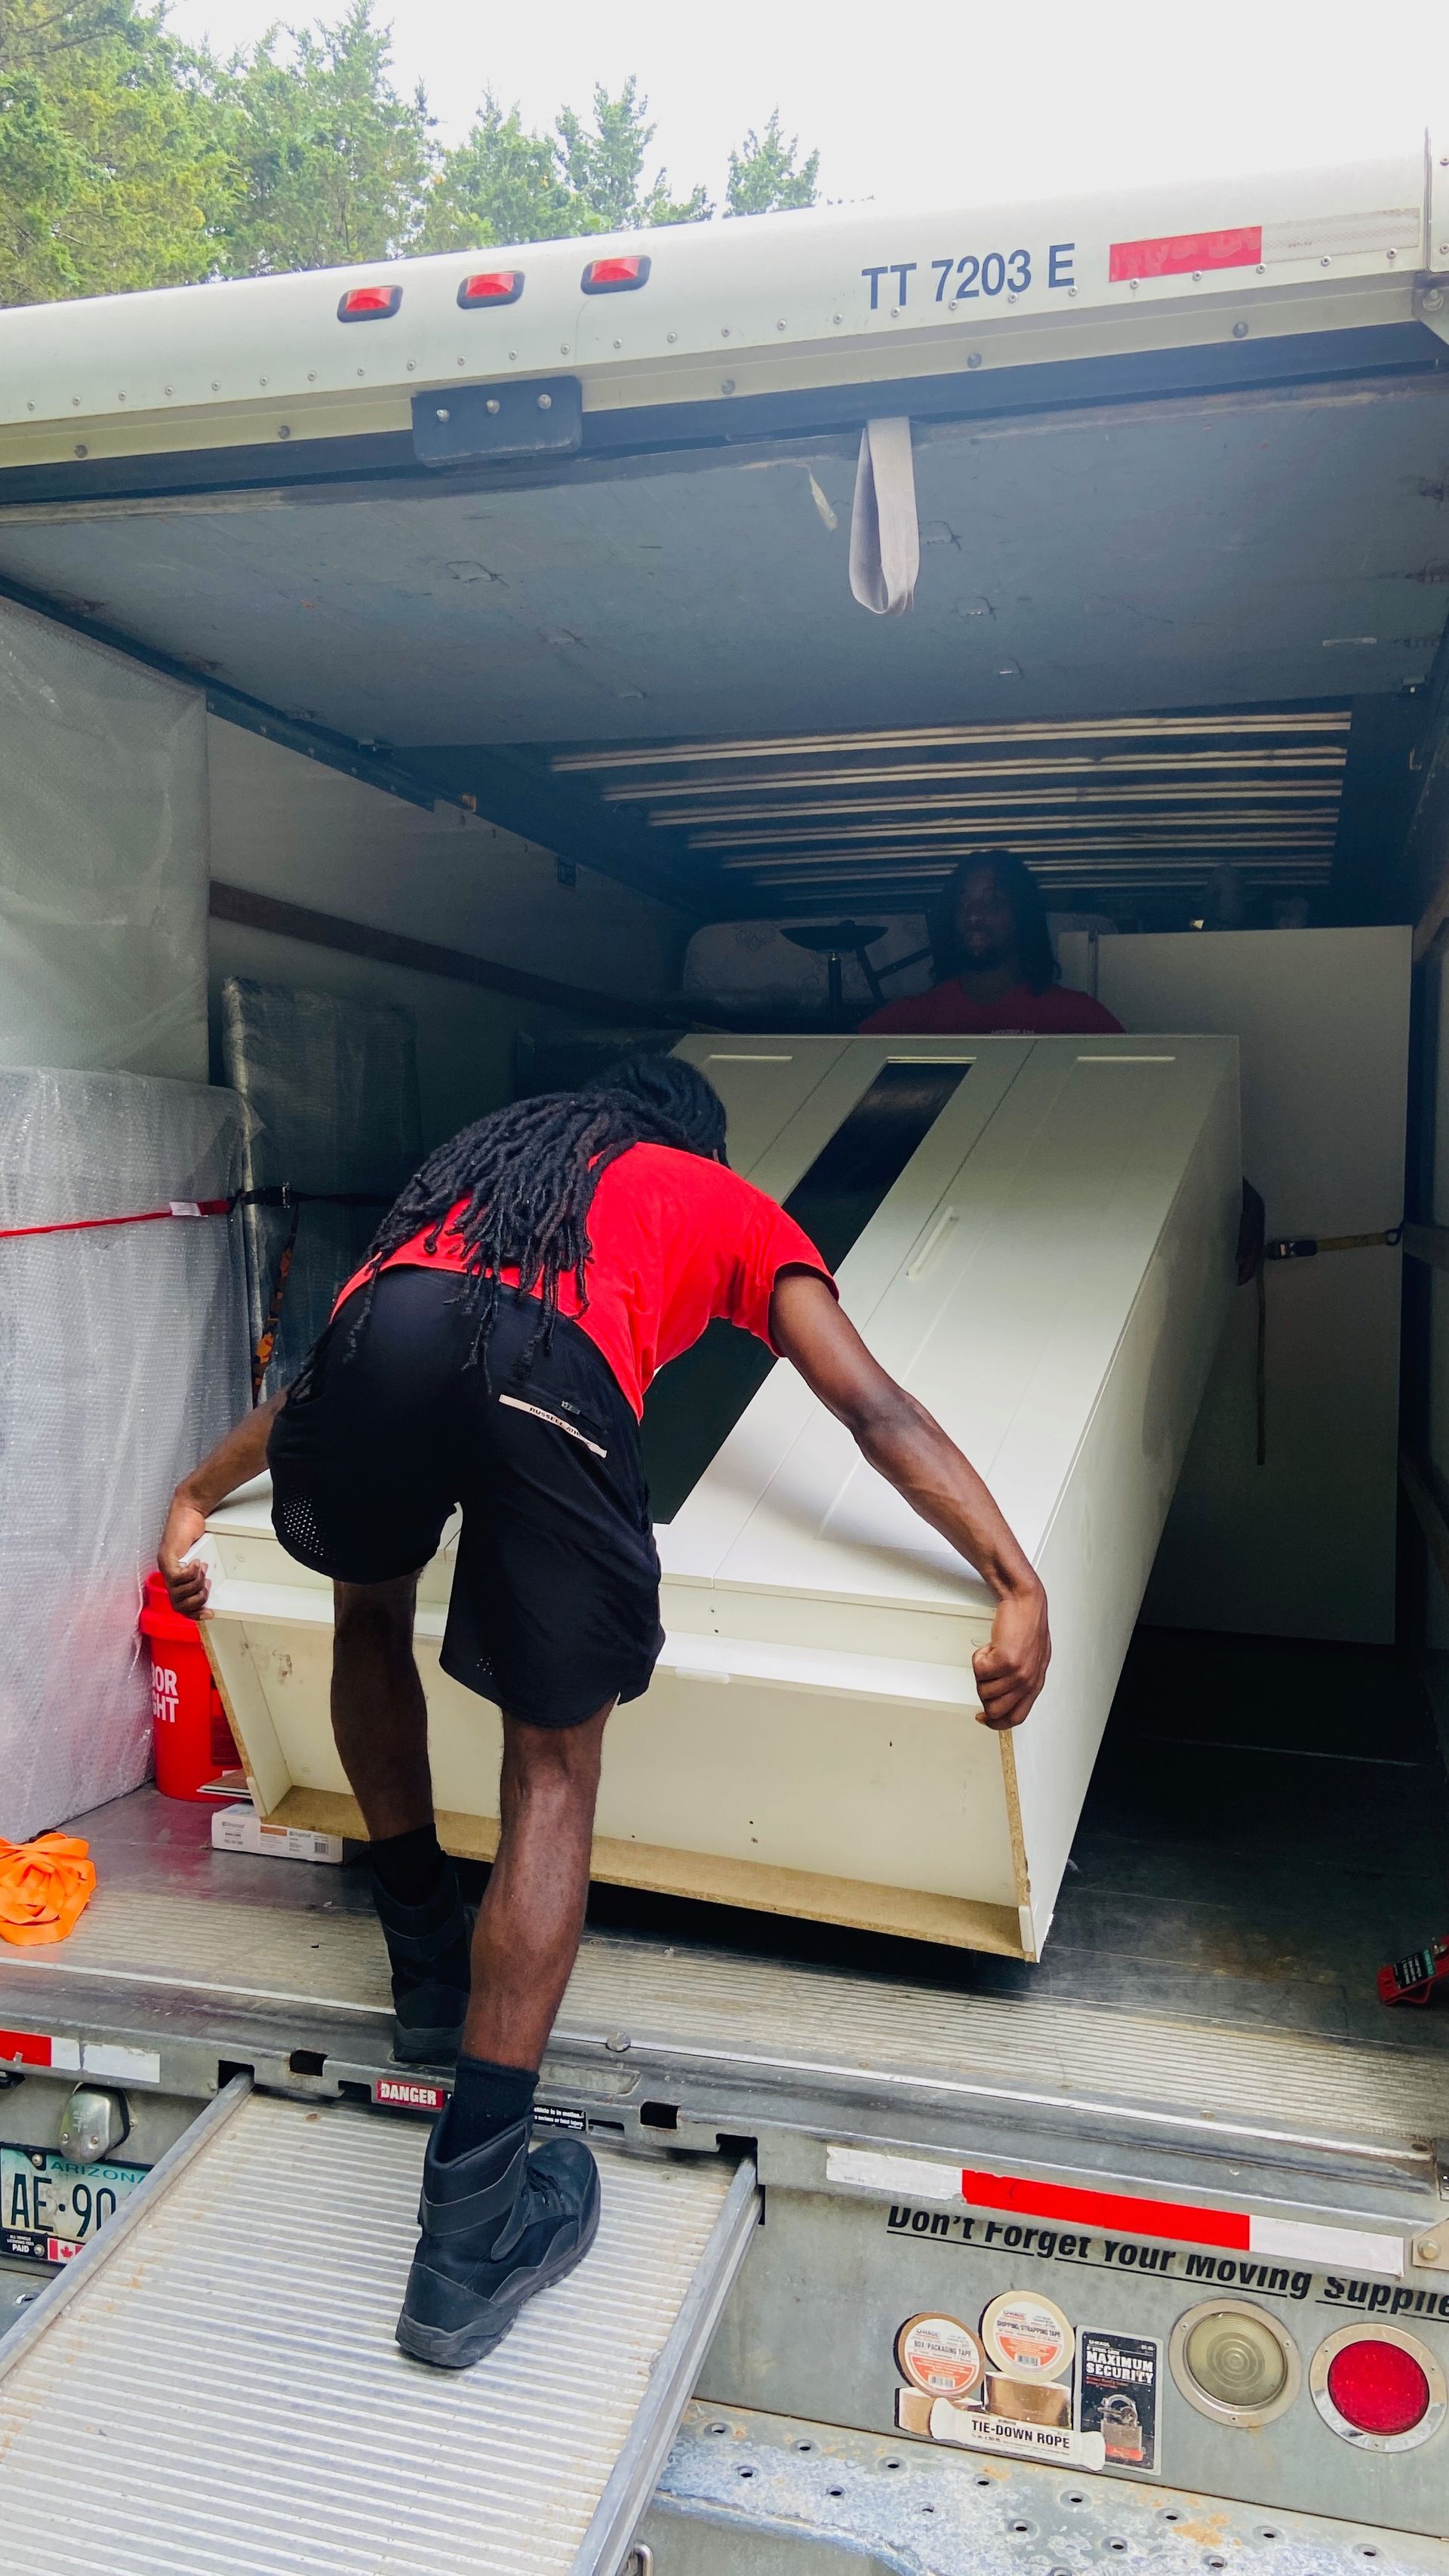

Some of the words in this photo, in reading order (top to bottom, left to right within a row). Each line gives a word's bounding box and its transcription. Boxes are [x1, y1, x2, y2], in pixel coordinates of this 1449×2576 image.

[862, 263, 916, 309] TT
[931, 250, 1032, 302] 7203
[1048, 242, 1075, 288] E
[380, 2083, 436, 2106] DANGER
[12, 2243, 29, 2253] PAID
[887, 2205, 975, 2240] Don't
[984, 2221, 1092, 2260] Forget
[1104, 2240, 1177, 2272] Your
[1186, 2253, 1312, 2300] Moving
[1049, 2330, 1061, 2338] TAPE
[958, 2348, 972, 2357] TAPE
[1086, 2350, 1153, 2372] MAXIMUM
[971, 2420, 1033, 2442] TIE-DOWN
[1037, 2432, 1070, 2448] ROPE
